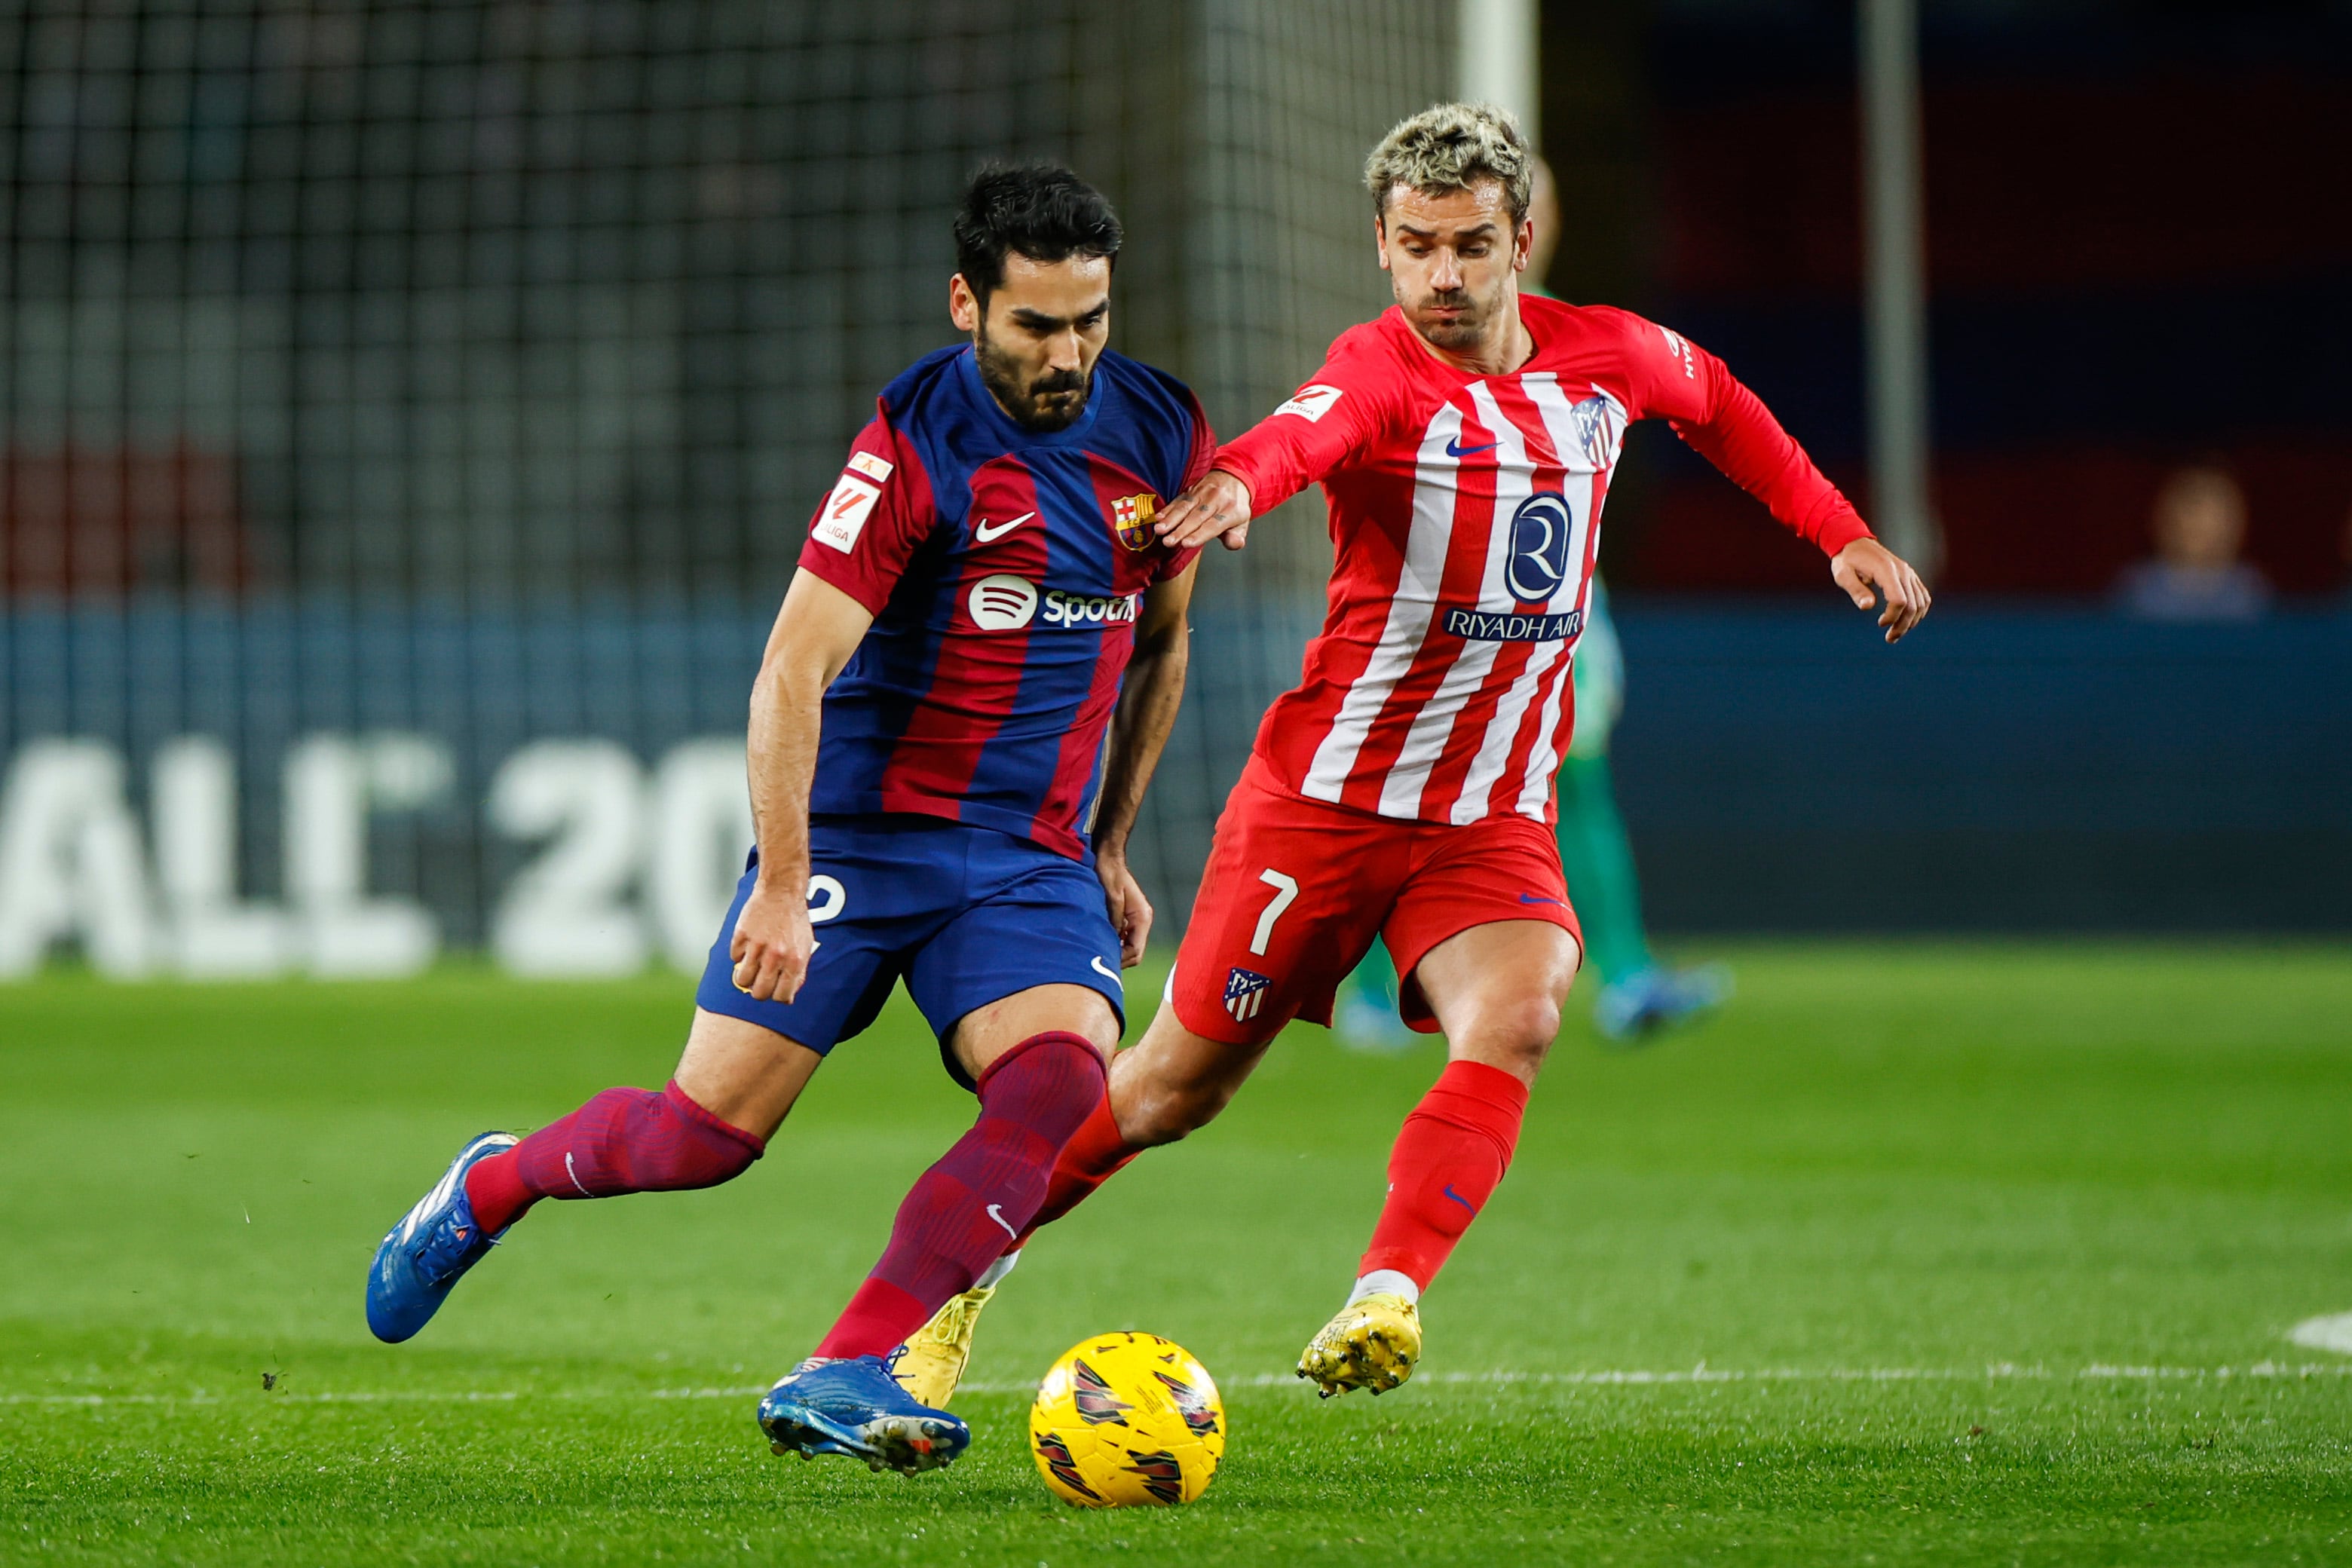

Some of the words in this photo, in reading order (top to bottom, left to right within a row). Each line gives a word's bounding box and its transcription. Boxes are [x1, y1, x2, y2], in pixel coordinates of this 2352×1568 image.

[820, 523, 849, 542] LIGA
[1448, 610, 1547, 639] RIYADH
[1548, 611, 1580, 639] AIR
[1259, 868, 1300, 957] 7
